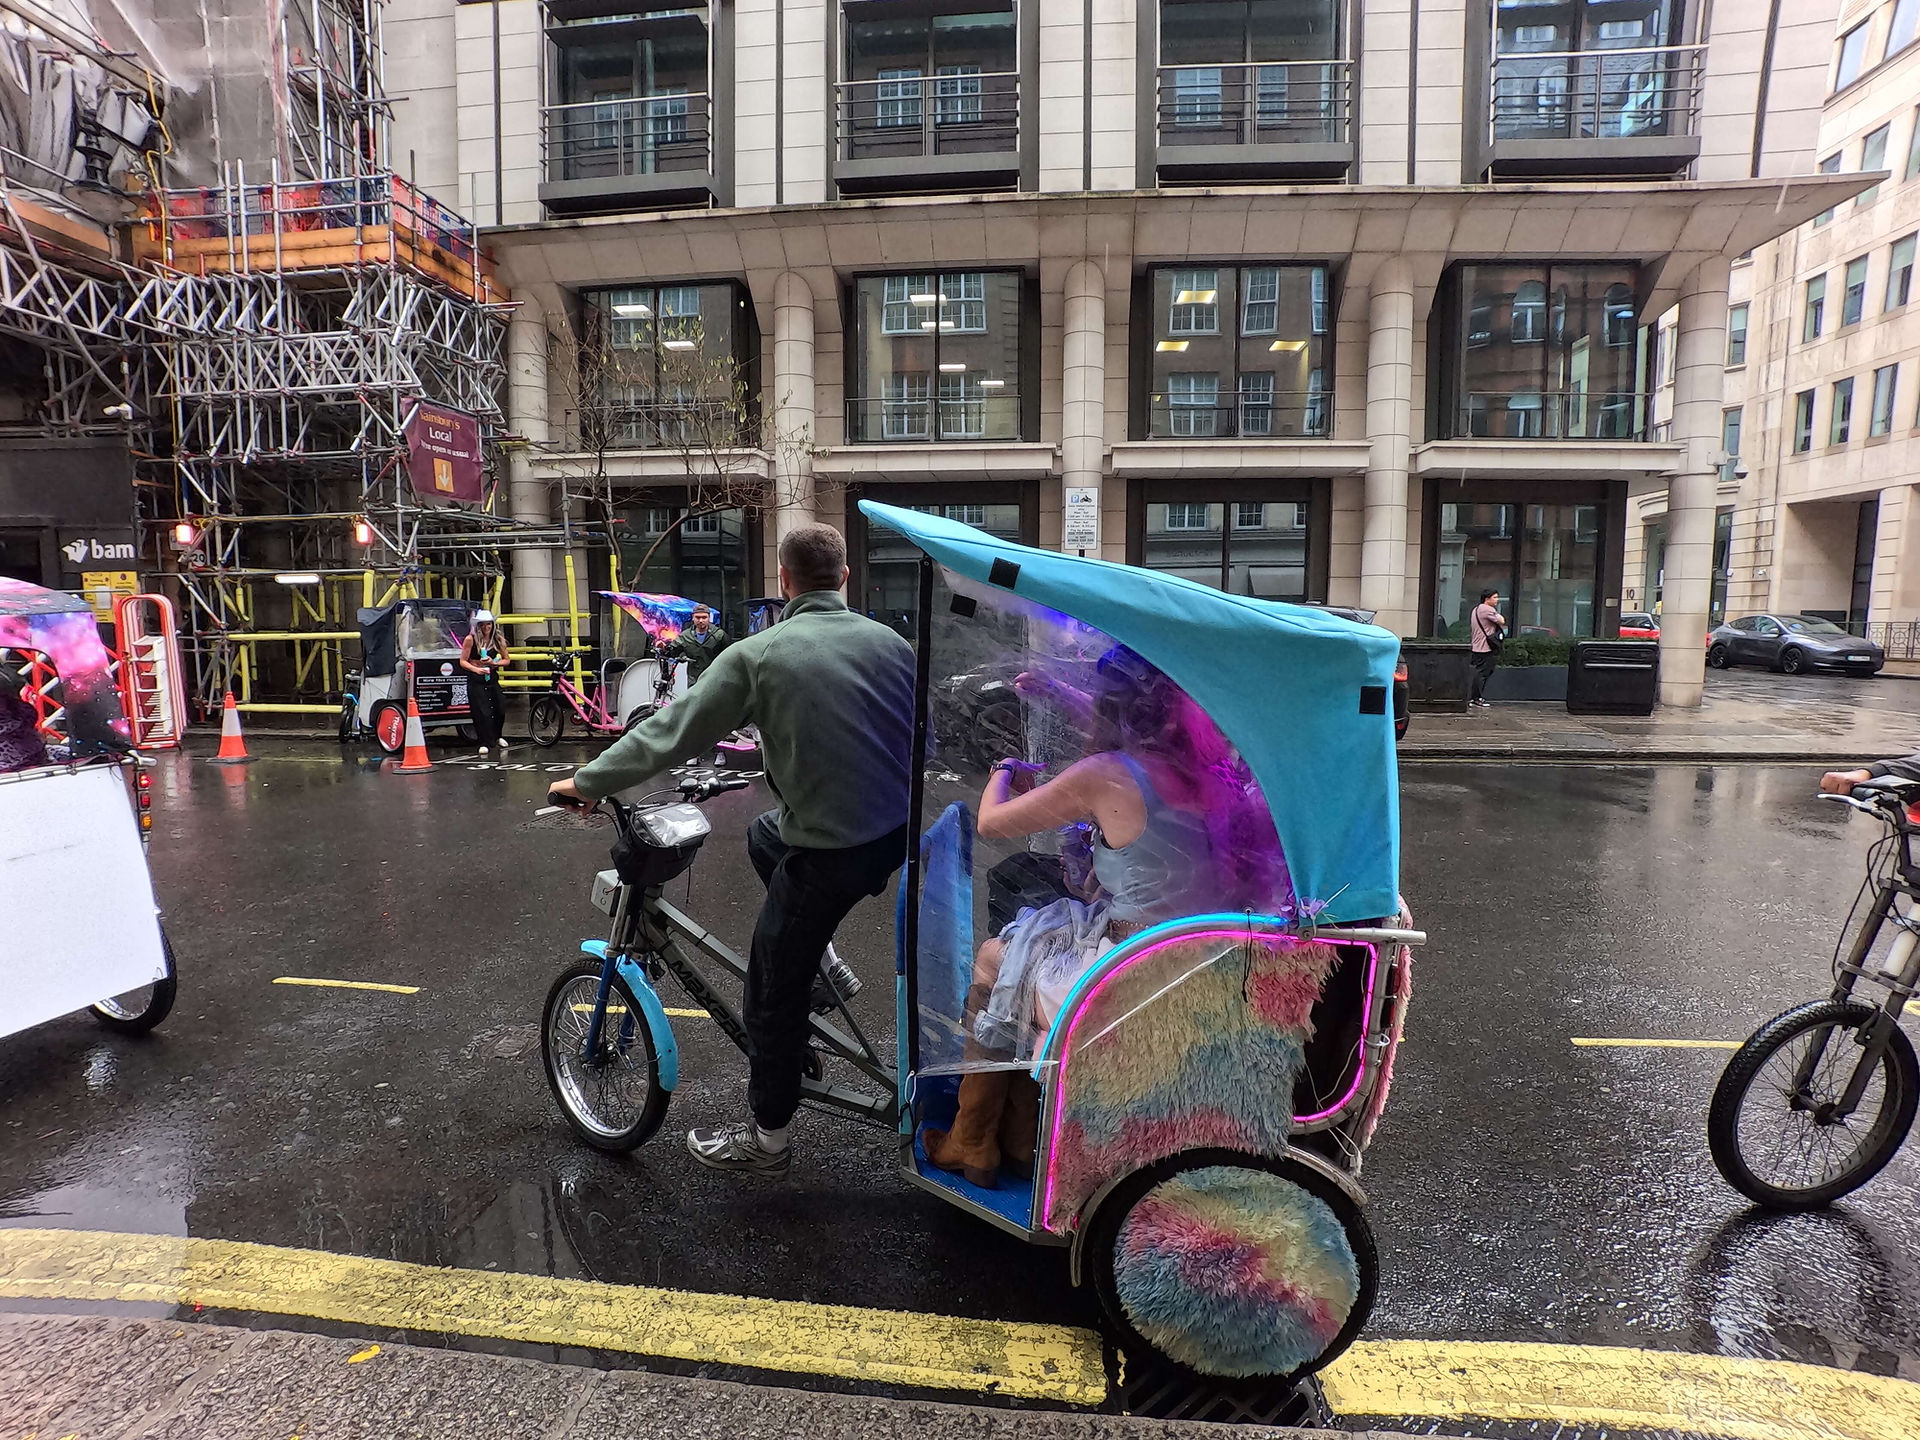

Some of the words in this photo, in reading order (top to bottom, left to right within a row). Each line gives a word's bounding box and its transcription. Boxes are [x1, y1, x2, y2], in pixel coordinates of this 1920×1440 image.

[429, 426, 453, 443] Local
[432, 444, 447, 454] open
[452, 450, 469, 458] usual
[91, 538, 135, 559] bam
[192, 553, 205, 563] 20
[1626, 588, 1636, 600] 10
[466, 763, 575, 772] SOLO
